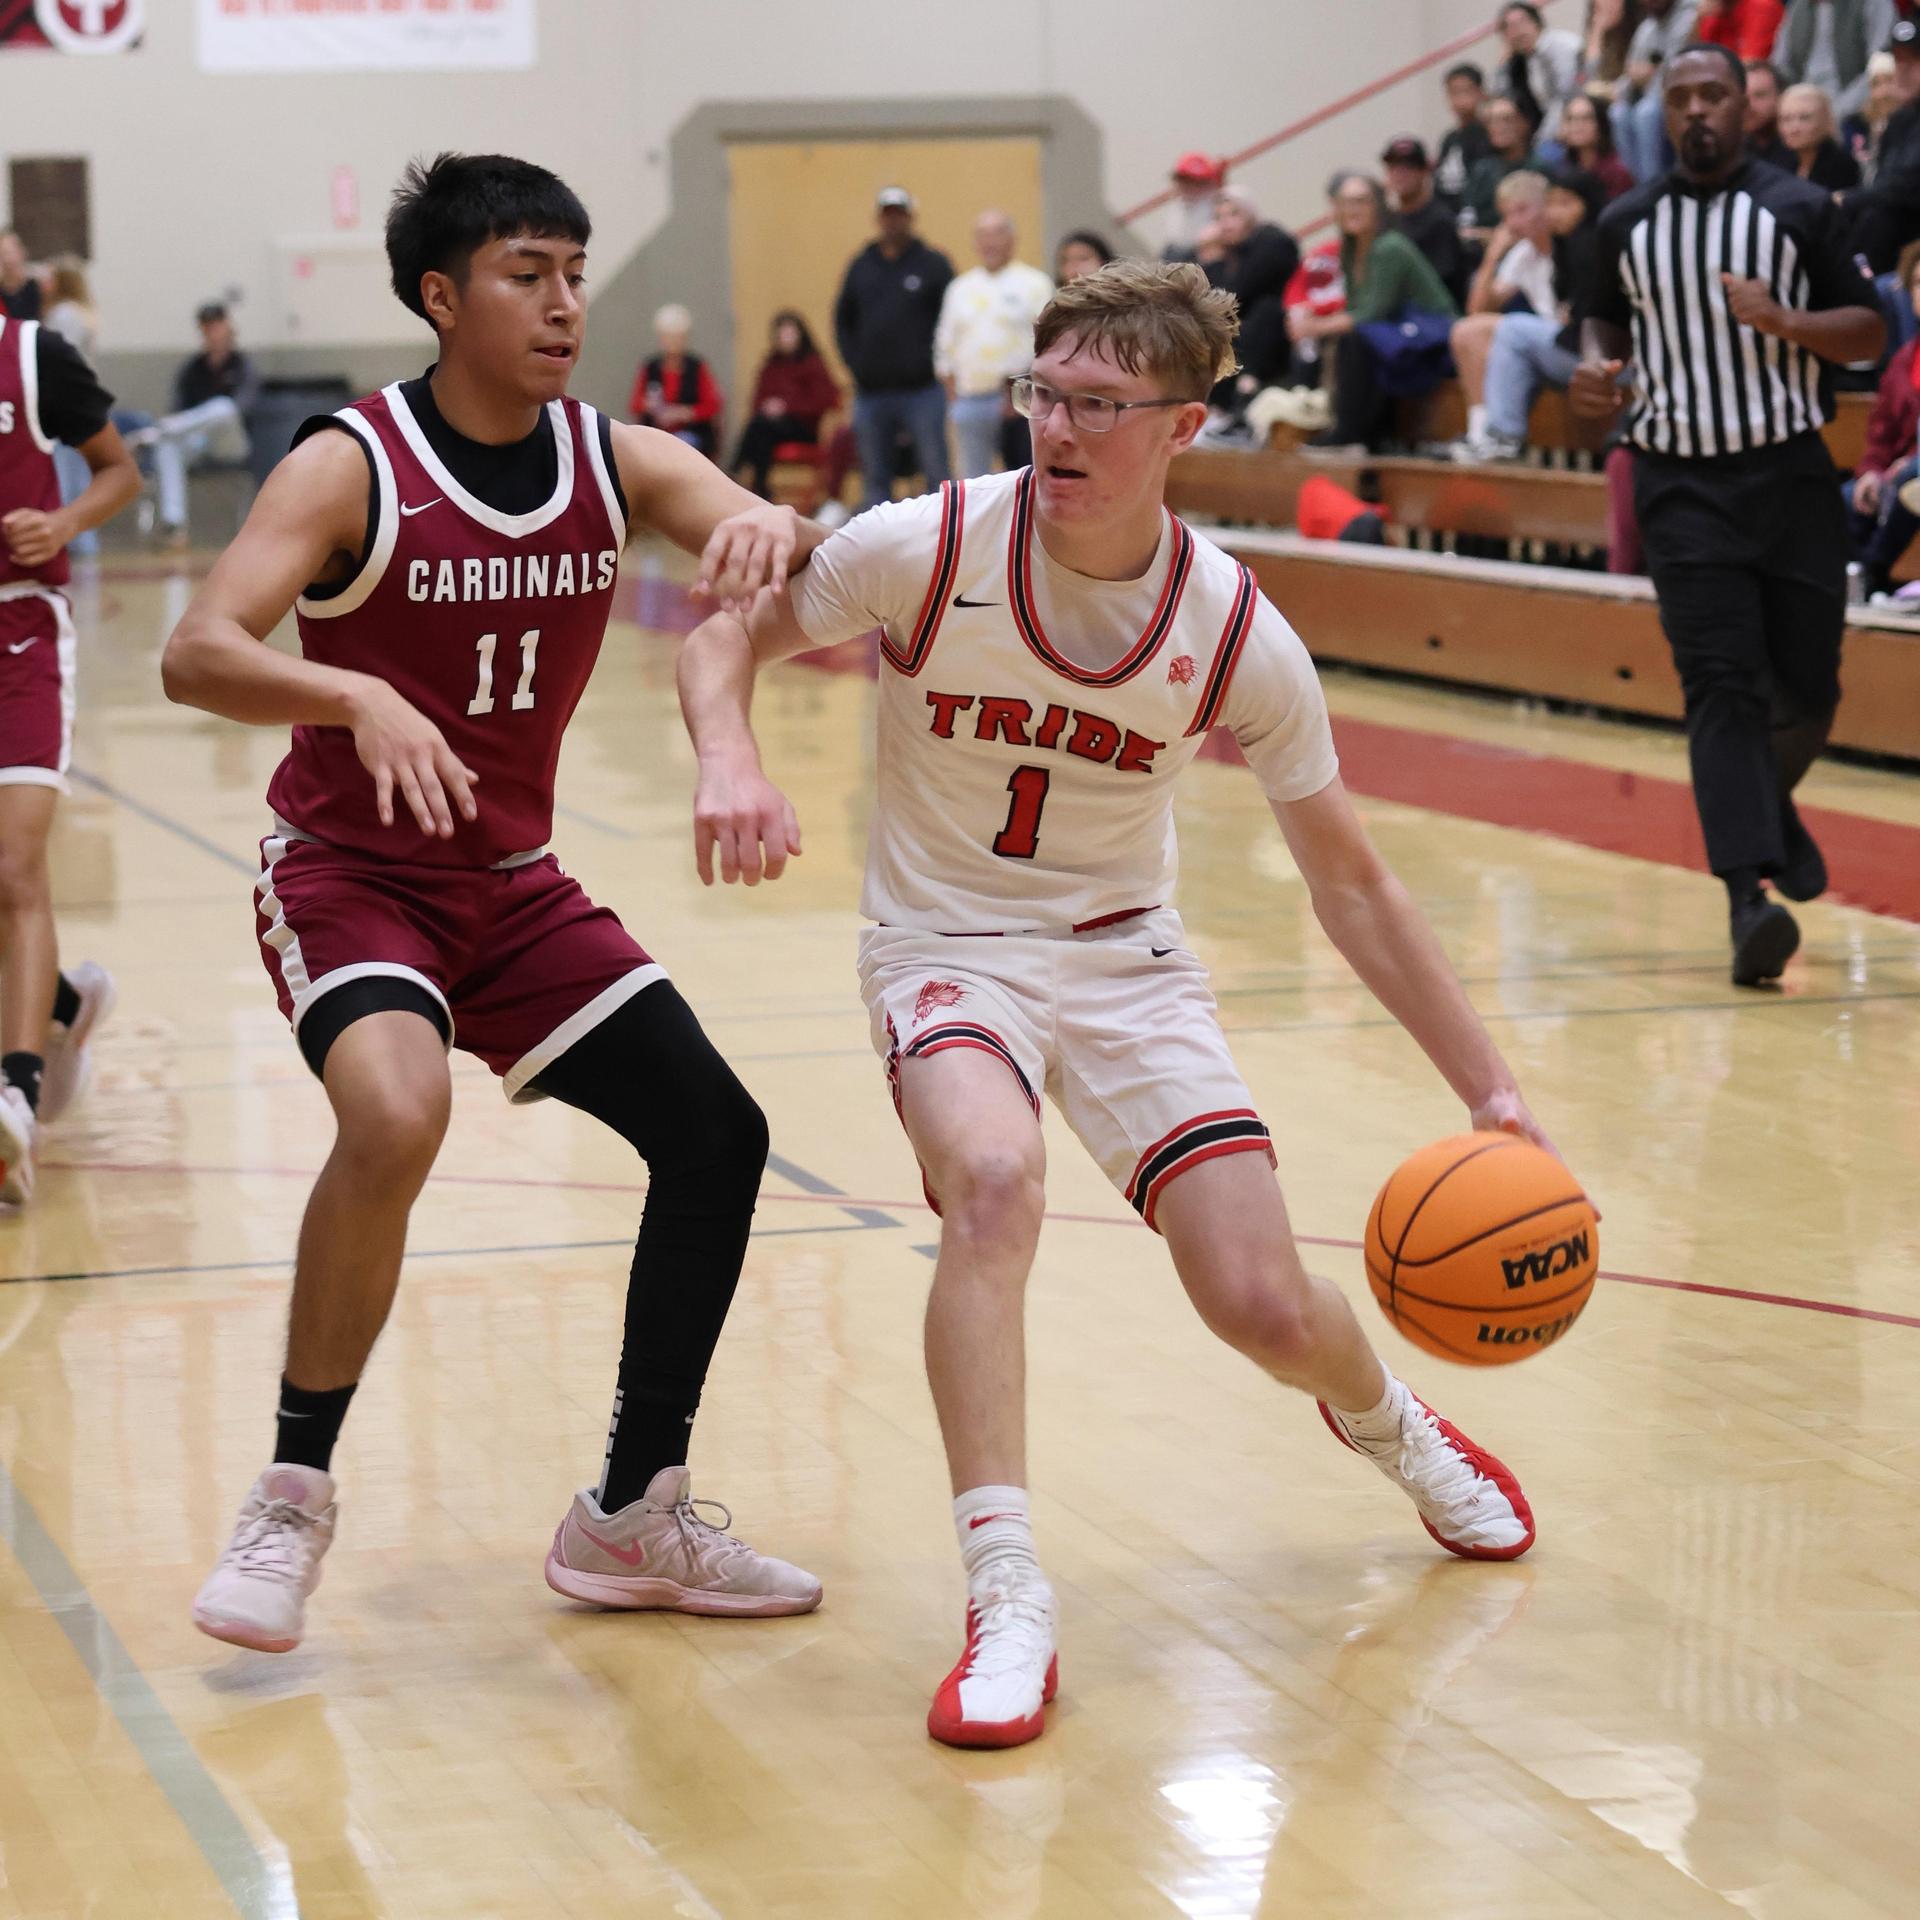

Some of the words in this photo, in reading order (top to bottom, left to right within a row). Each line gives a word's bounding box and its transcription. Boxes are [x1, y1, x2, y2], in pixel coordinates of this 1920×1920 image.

[407, 549, 617, 602] CARDINALS
[467, 629, 540, 716] 11
[926, 690, 1167, 774] TRIBE
[992, 765, 1050, 859] 1
[1502, 1230, 1589, 1289] NCAA
